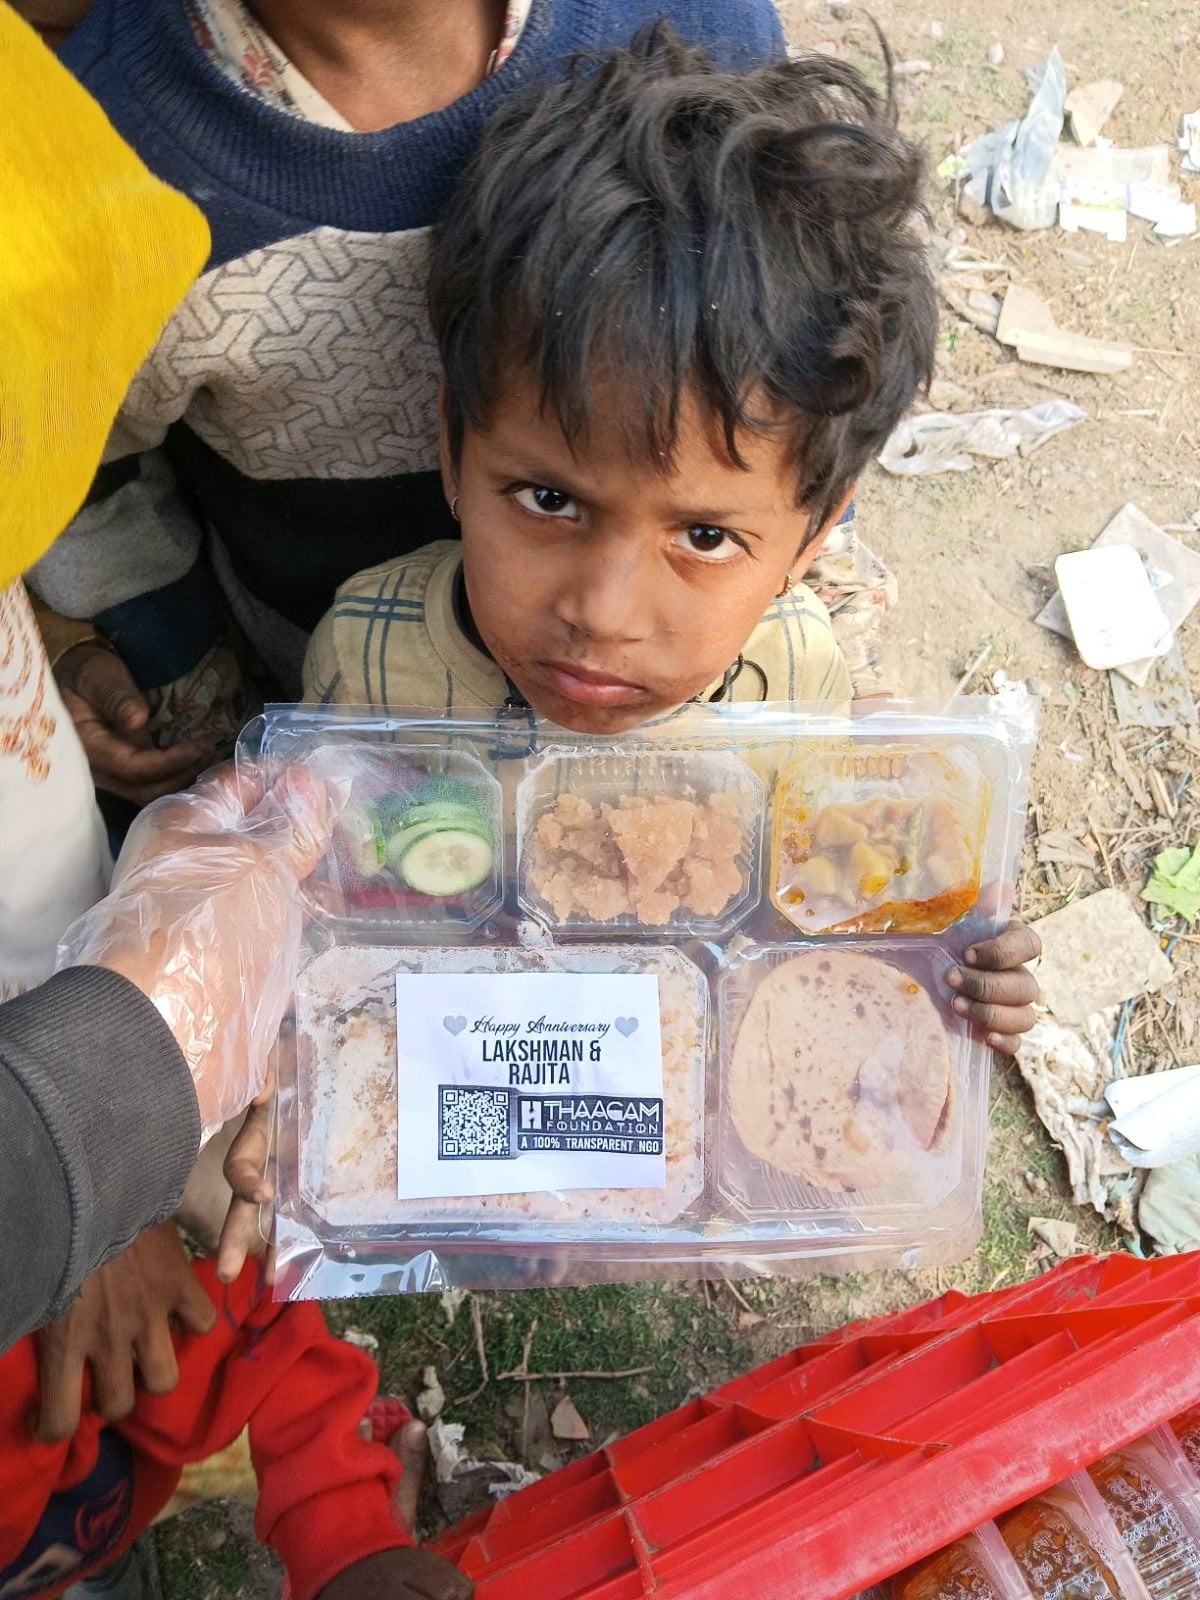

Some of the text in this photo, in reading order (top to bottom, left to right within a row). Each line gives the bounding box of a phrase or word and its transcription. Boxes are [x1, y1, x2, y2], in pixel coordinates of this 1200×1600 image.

[470, 1015, 611, 1038] Happy Anniversary
[482, 1039, 602, 1062] LAKSHMAN &
[508, 1063, 571, 1085] RAJITA
[543, 1100, 660, 1122] THAAGAM
[546, 1121, 659, 1135] FOUNDATION
[520, 1136, 659, 1152] A 100% TRANSPARENT NGO
